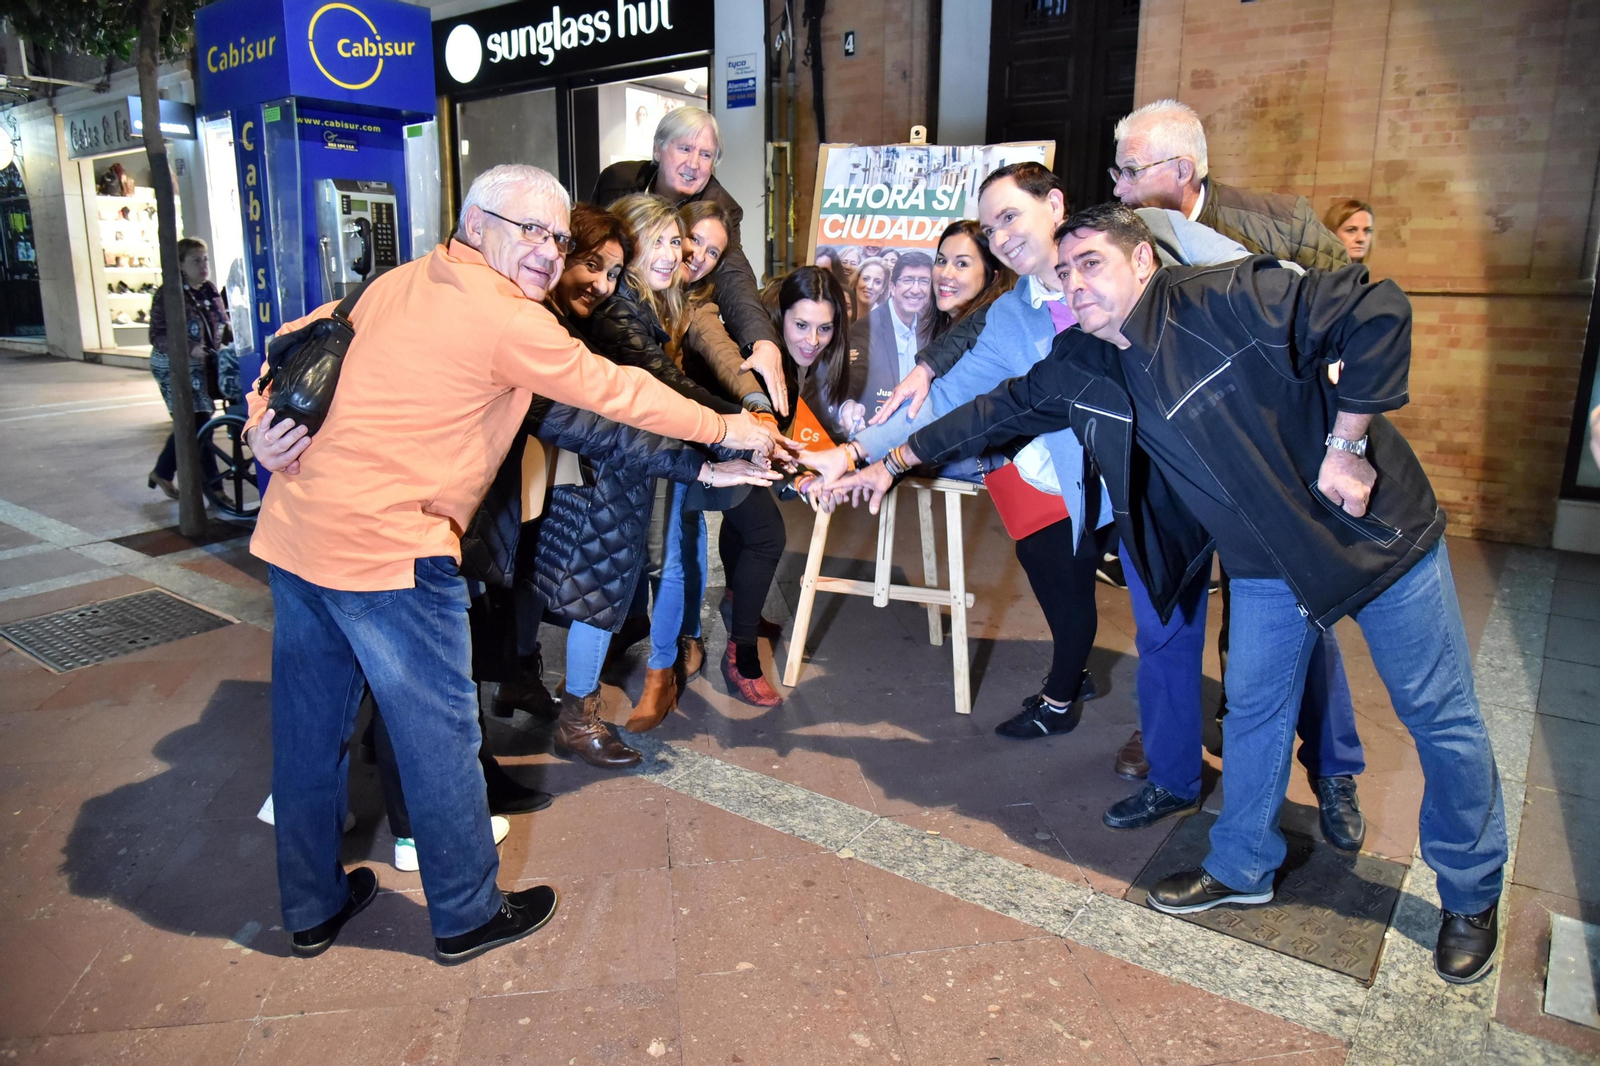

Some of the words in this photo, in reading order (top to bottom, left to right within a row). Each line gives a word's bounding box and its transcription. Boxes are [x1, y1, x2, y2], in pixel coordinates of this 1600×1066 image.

[337, 34, 416, 58] Cabisur
[487, 5, 611, 66] sunglass
[617, 0, 673, 39] hut
[844, 34, 854, 53] 4
[207, 35, 276, 73] Cabisur
[728, 61, 746, 69] tyco
[102, 115, 113, 145] &
[296, 118, 382, 132] www.cabisur.com
[823, 183, 926, 209] AHORA
[932, 179, 968, 211] SÍ
[823, 213, 976, 241] CIUDADA
[800, 427, 820, 443] Cs
